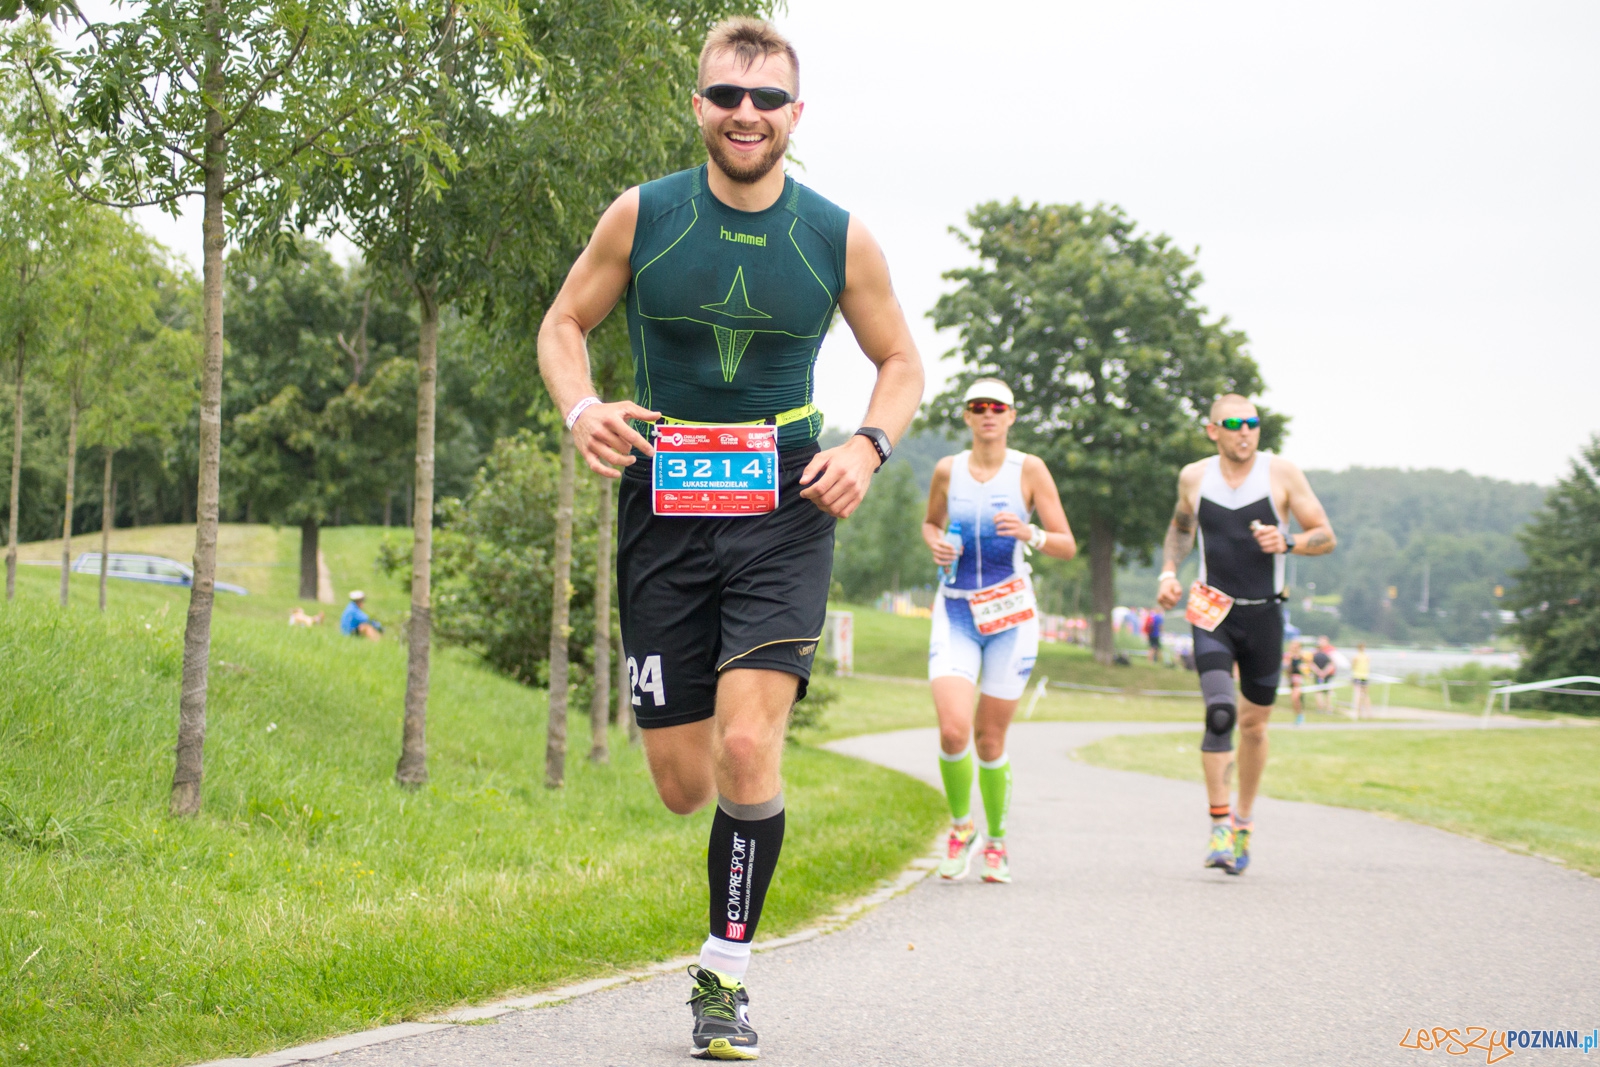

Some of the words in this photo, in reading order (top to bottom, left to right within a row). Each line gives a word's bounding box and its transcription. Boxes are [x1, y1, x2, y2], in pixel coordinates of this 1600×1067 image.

[720, 225, 767, 247] hummel
[668, 459, 763, 478] 3214
[682, 480, 708, 488] ŁUKASZ
[708, 480, 749, 488] NIEDZIELAK
[626, 655, 666, 707] 24
